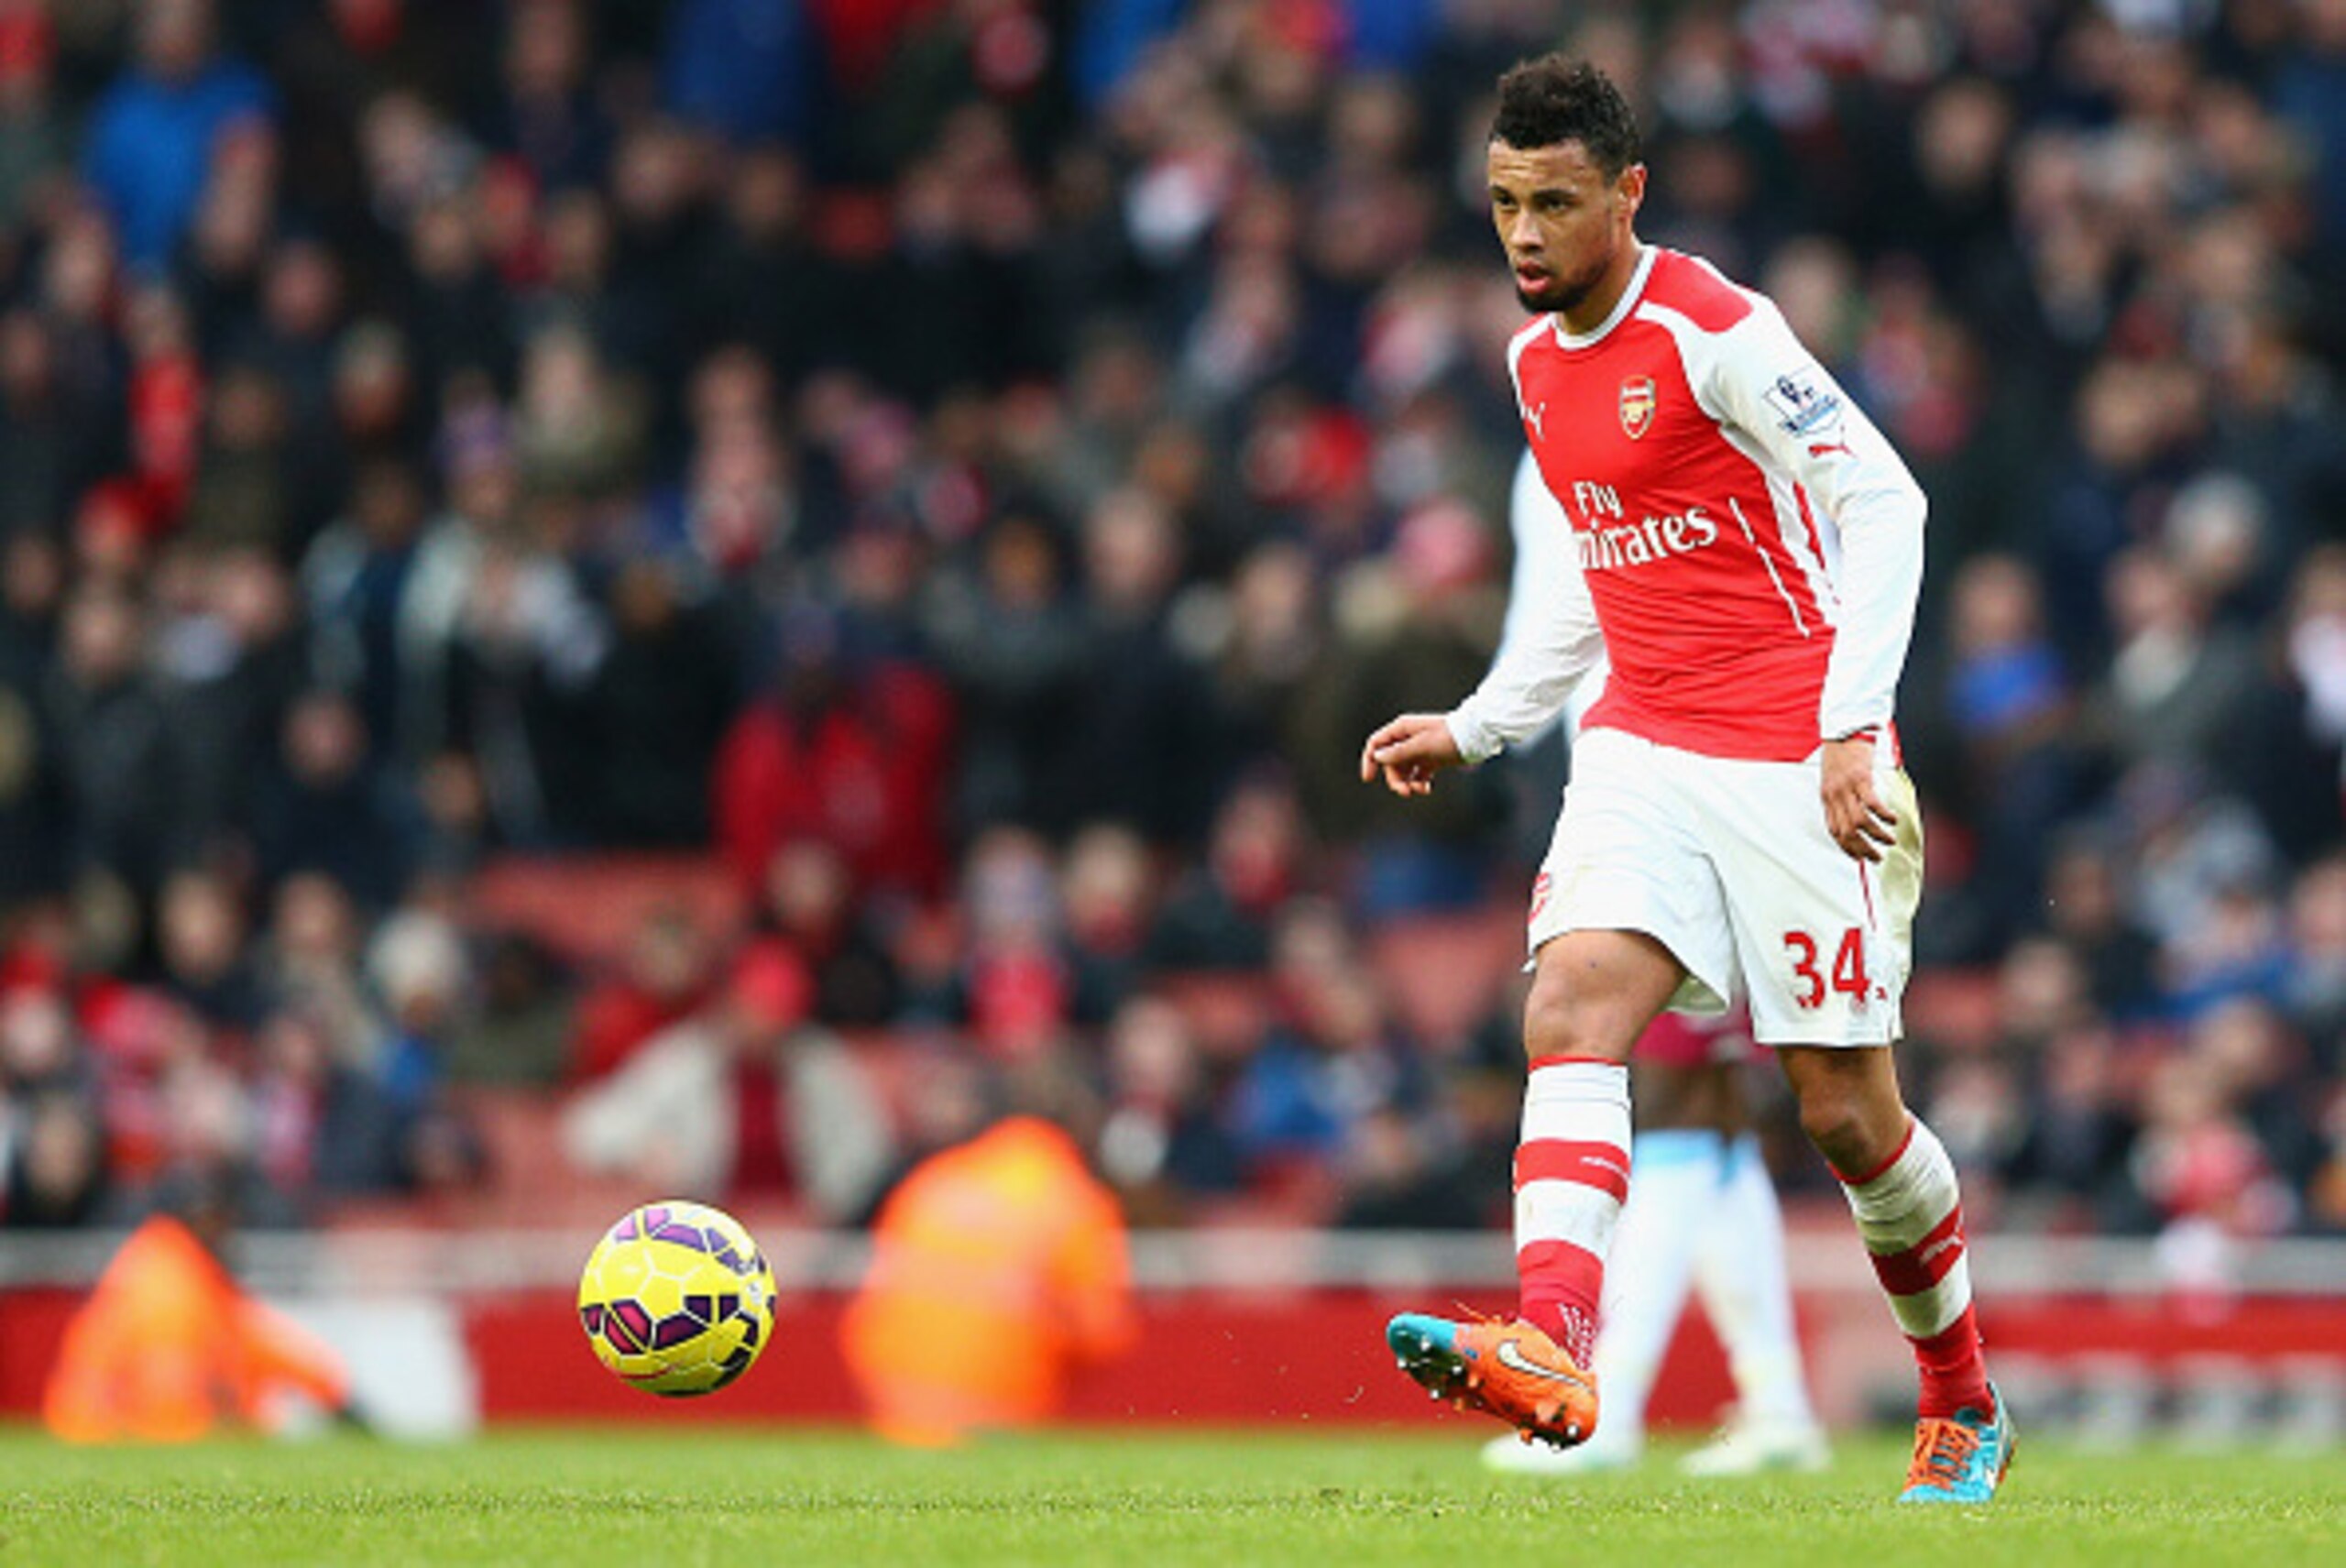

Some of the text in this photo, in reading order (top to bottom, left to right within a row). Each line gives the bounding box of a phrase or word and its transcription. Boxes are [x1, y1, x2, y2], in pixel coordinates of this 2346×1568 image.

[1573, 481, 1623, 519] Fly
[1573, 506, 1717, 569] mirates
[1783, 927, 1871, 1008] 34
